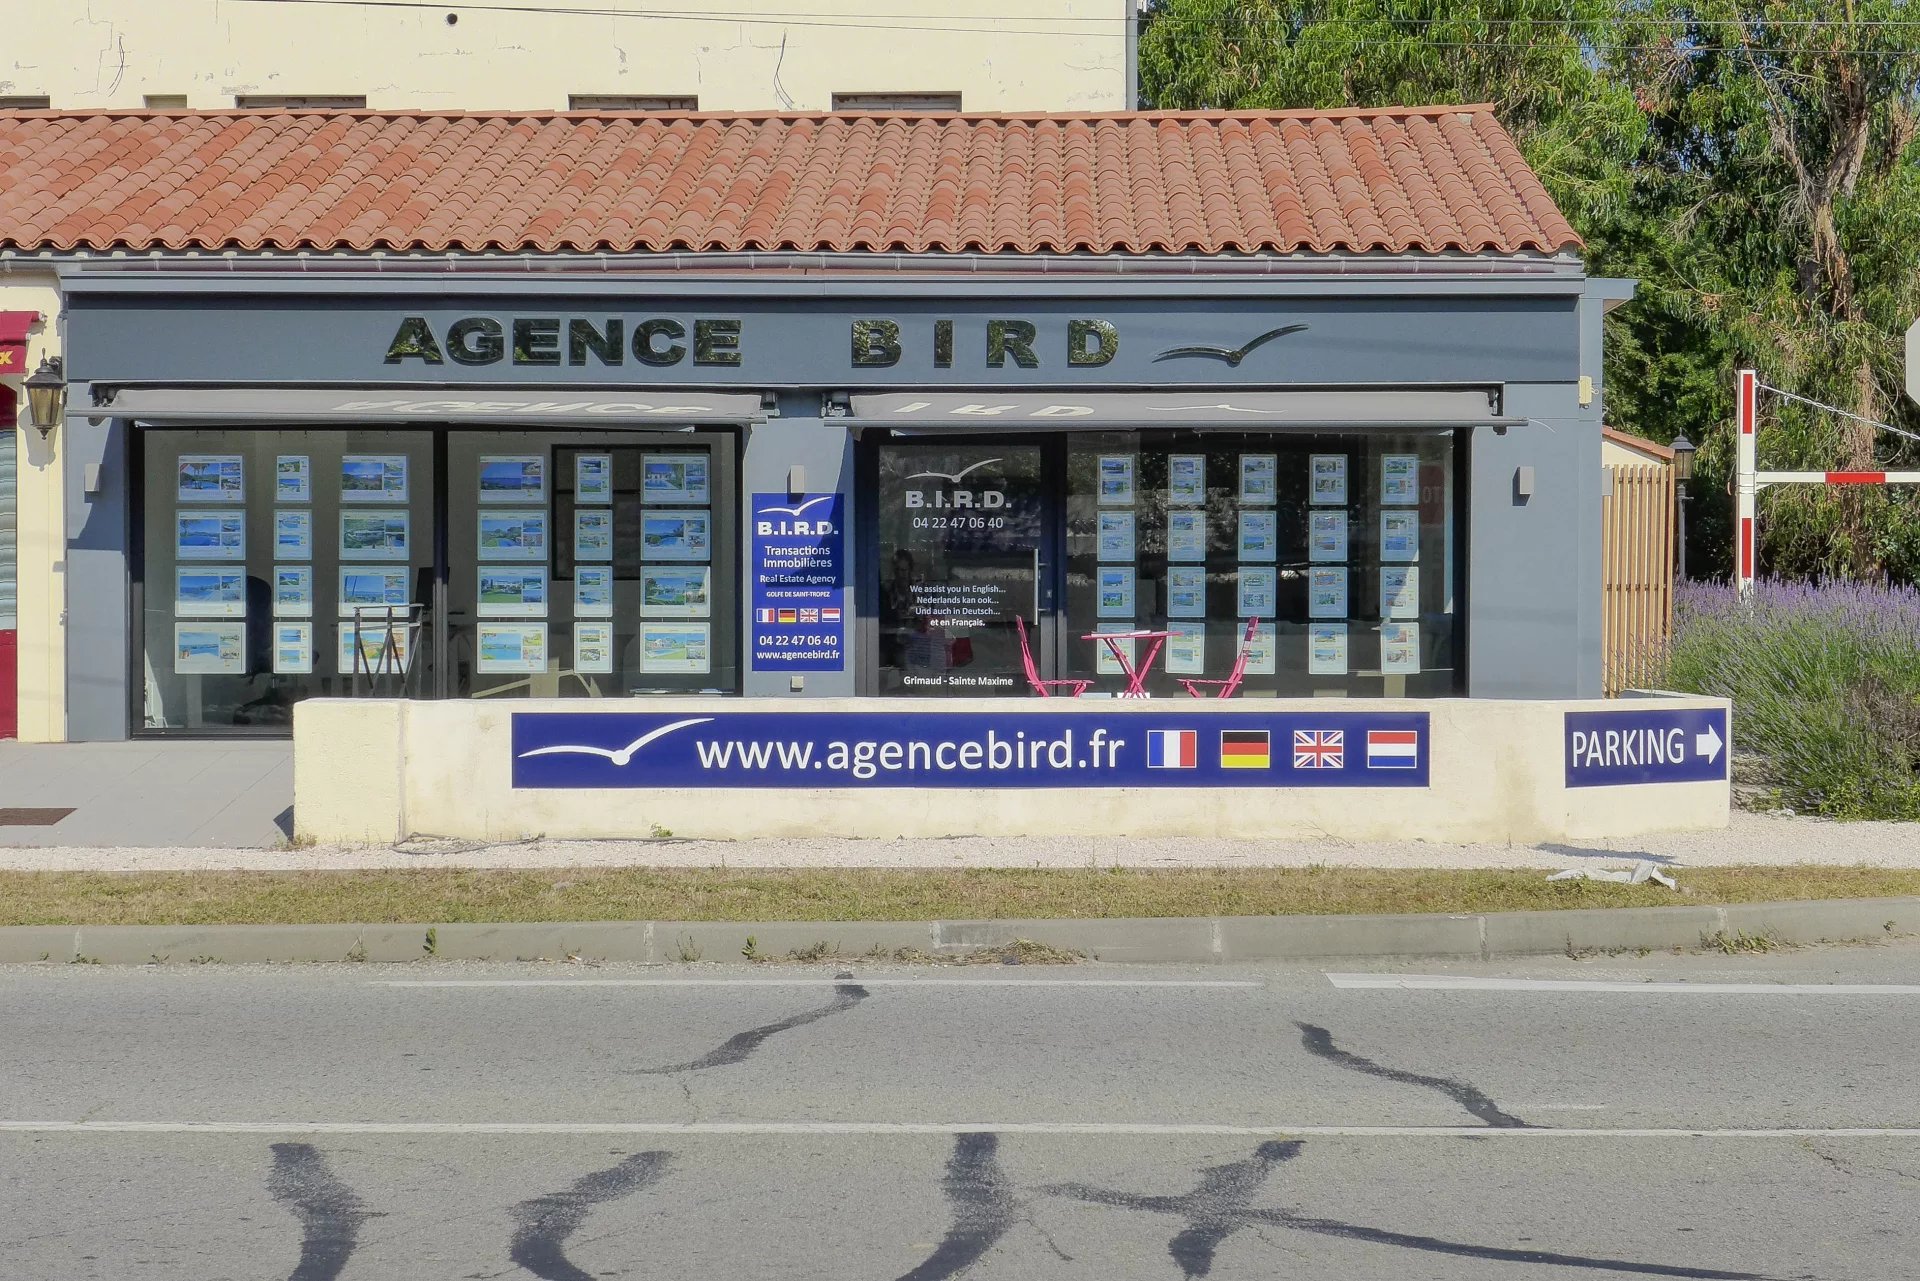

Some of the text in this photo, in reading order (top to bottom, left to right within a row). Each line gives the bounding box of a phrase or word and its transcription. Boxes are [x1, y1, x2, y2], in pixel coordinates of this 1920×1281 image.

[384, 316, 1119, 368] AGENCE BIRD
[905, 490, 1012, 509] B.I.R.D.
[757, 521, 839, 536] B.I.R.D.
[913, 517, 1004, 529] 04 22 47 06 40
[765, 545, 831, 556] Transactions
[763, 557, 832, 568] Immobilières
[760, 574, 836, 585] Real Estate Agency
[909, 585, 923, 593] We
[924, 585, 945, 593] assist
[962, 585, 970, 593] in
[972, 585, 1006, 594] English...
[916, 596, 999, 604] Nederlands kan ook...
[915, 607, 1001, 615] Und auch in Deutsch...
[951, 618, 986, 628] Français.
[759, 636, 837, 646] 04 22 47 06 40
[757, 650, 840, 661] www.agencebird.fr
[903, 676, 942, 685] Grimaud
[949, 676, 976, 685] Sainte
[978, 676, 1014, 686] Maxime
[1572, 727, 1684, 767] PARKING
[696, 728, 1126, 778] www.agencebird.fr
